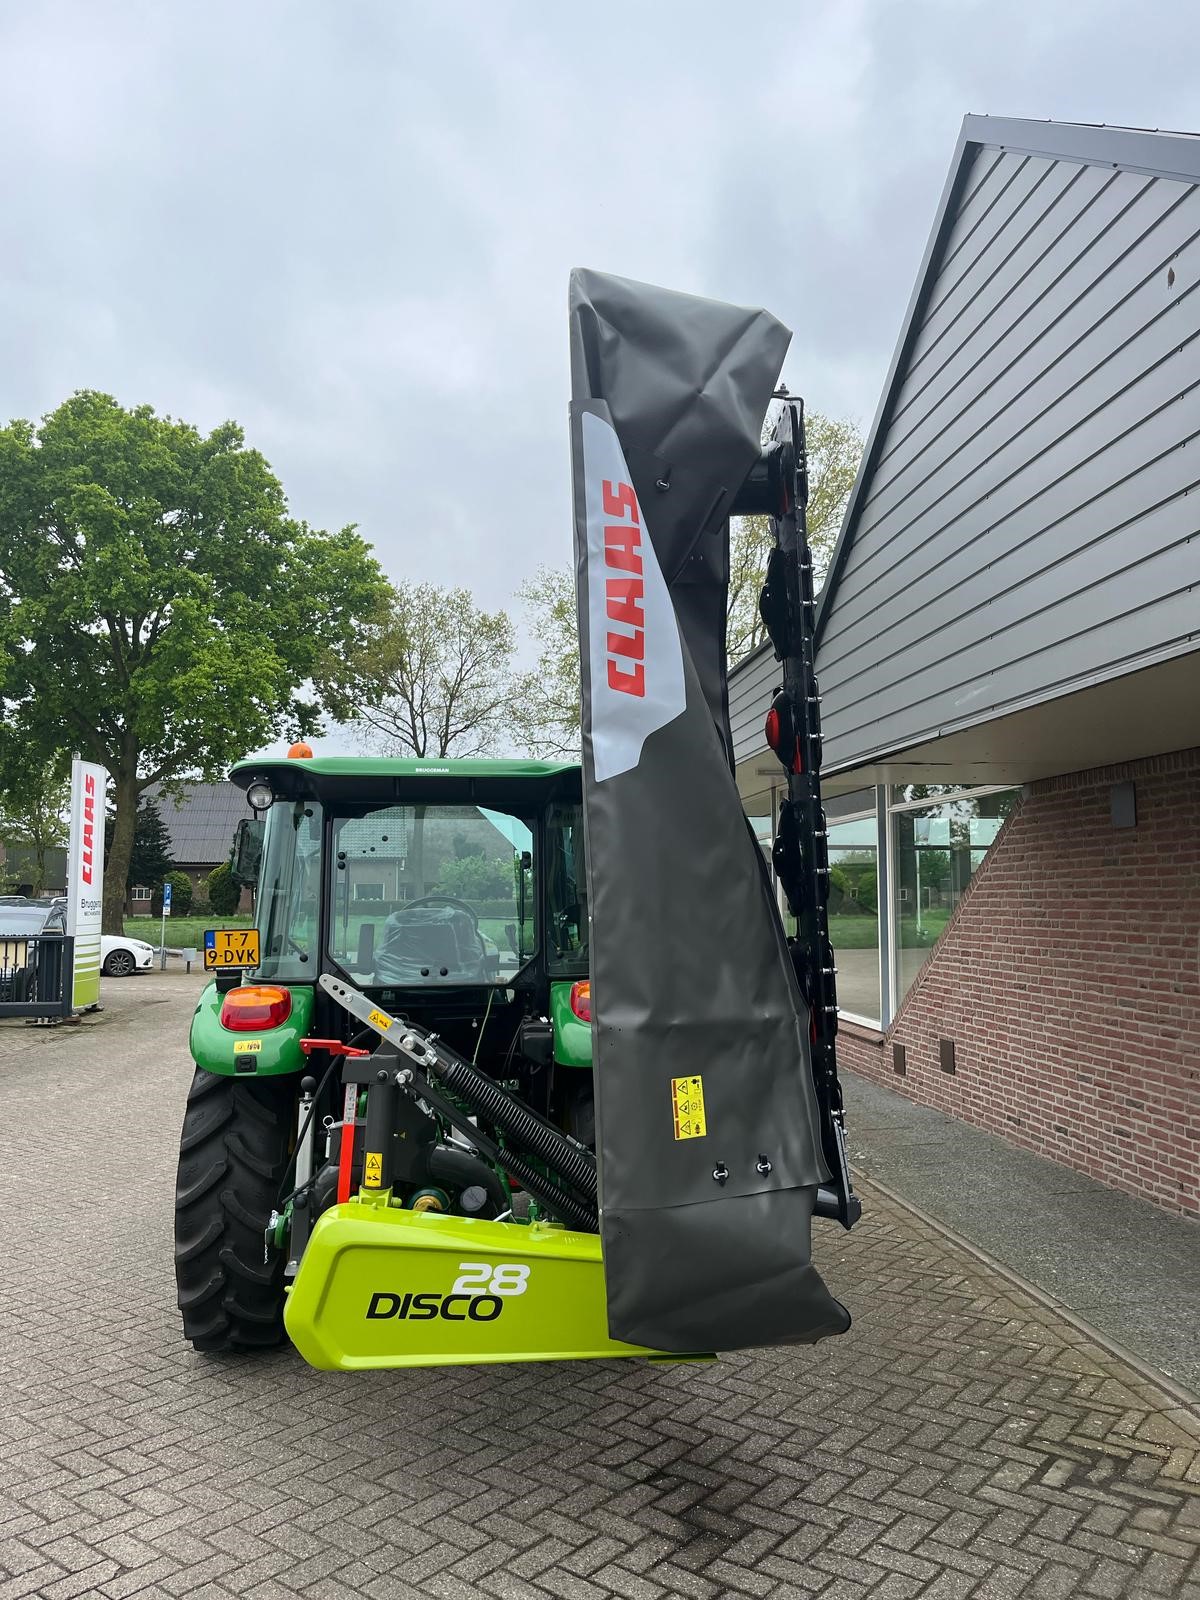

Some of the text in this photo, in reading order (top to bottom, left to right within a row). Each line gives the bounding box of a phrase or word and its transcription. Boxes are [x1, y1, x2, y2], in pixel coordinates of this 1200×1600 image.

[602, 479, 645, 698] CLAAS
[82, 774, 95, 885] CLAAS
[208, 949, 257, 964] 9-DVK
[451, 1262, 531, 1296] 28
[366, 1292, 503, 1321] DISCO
